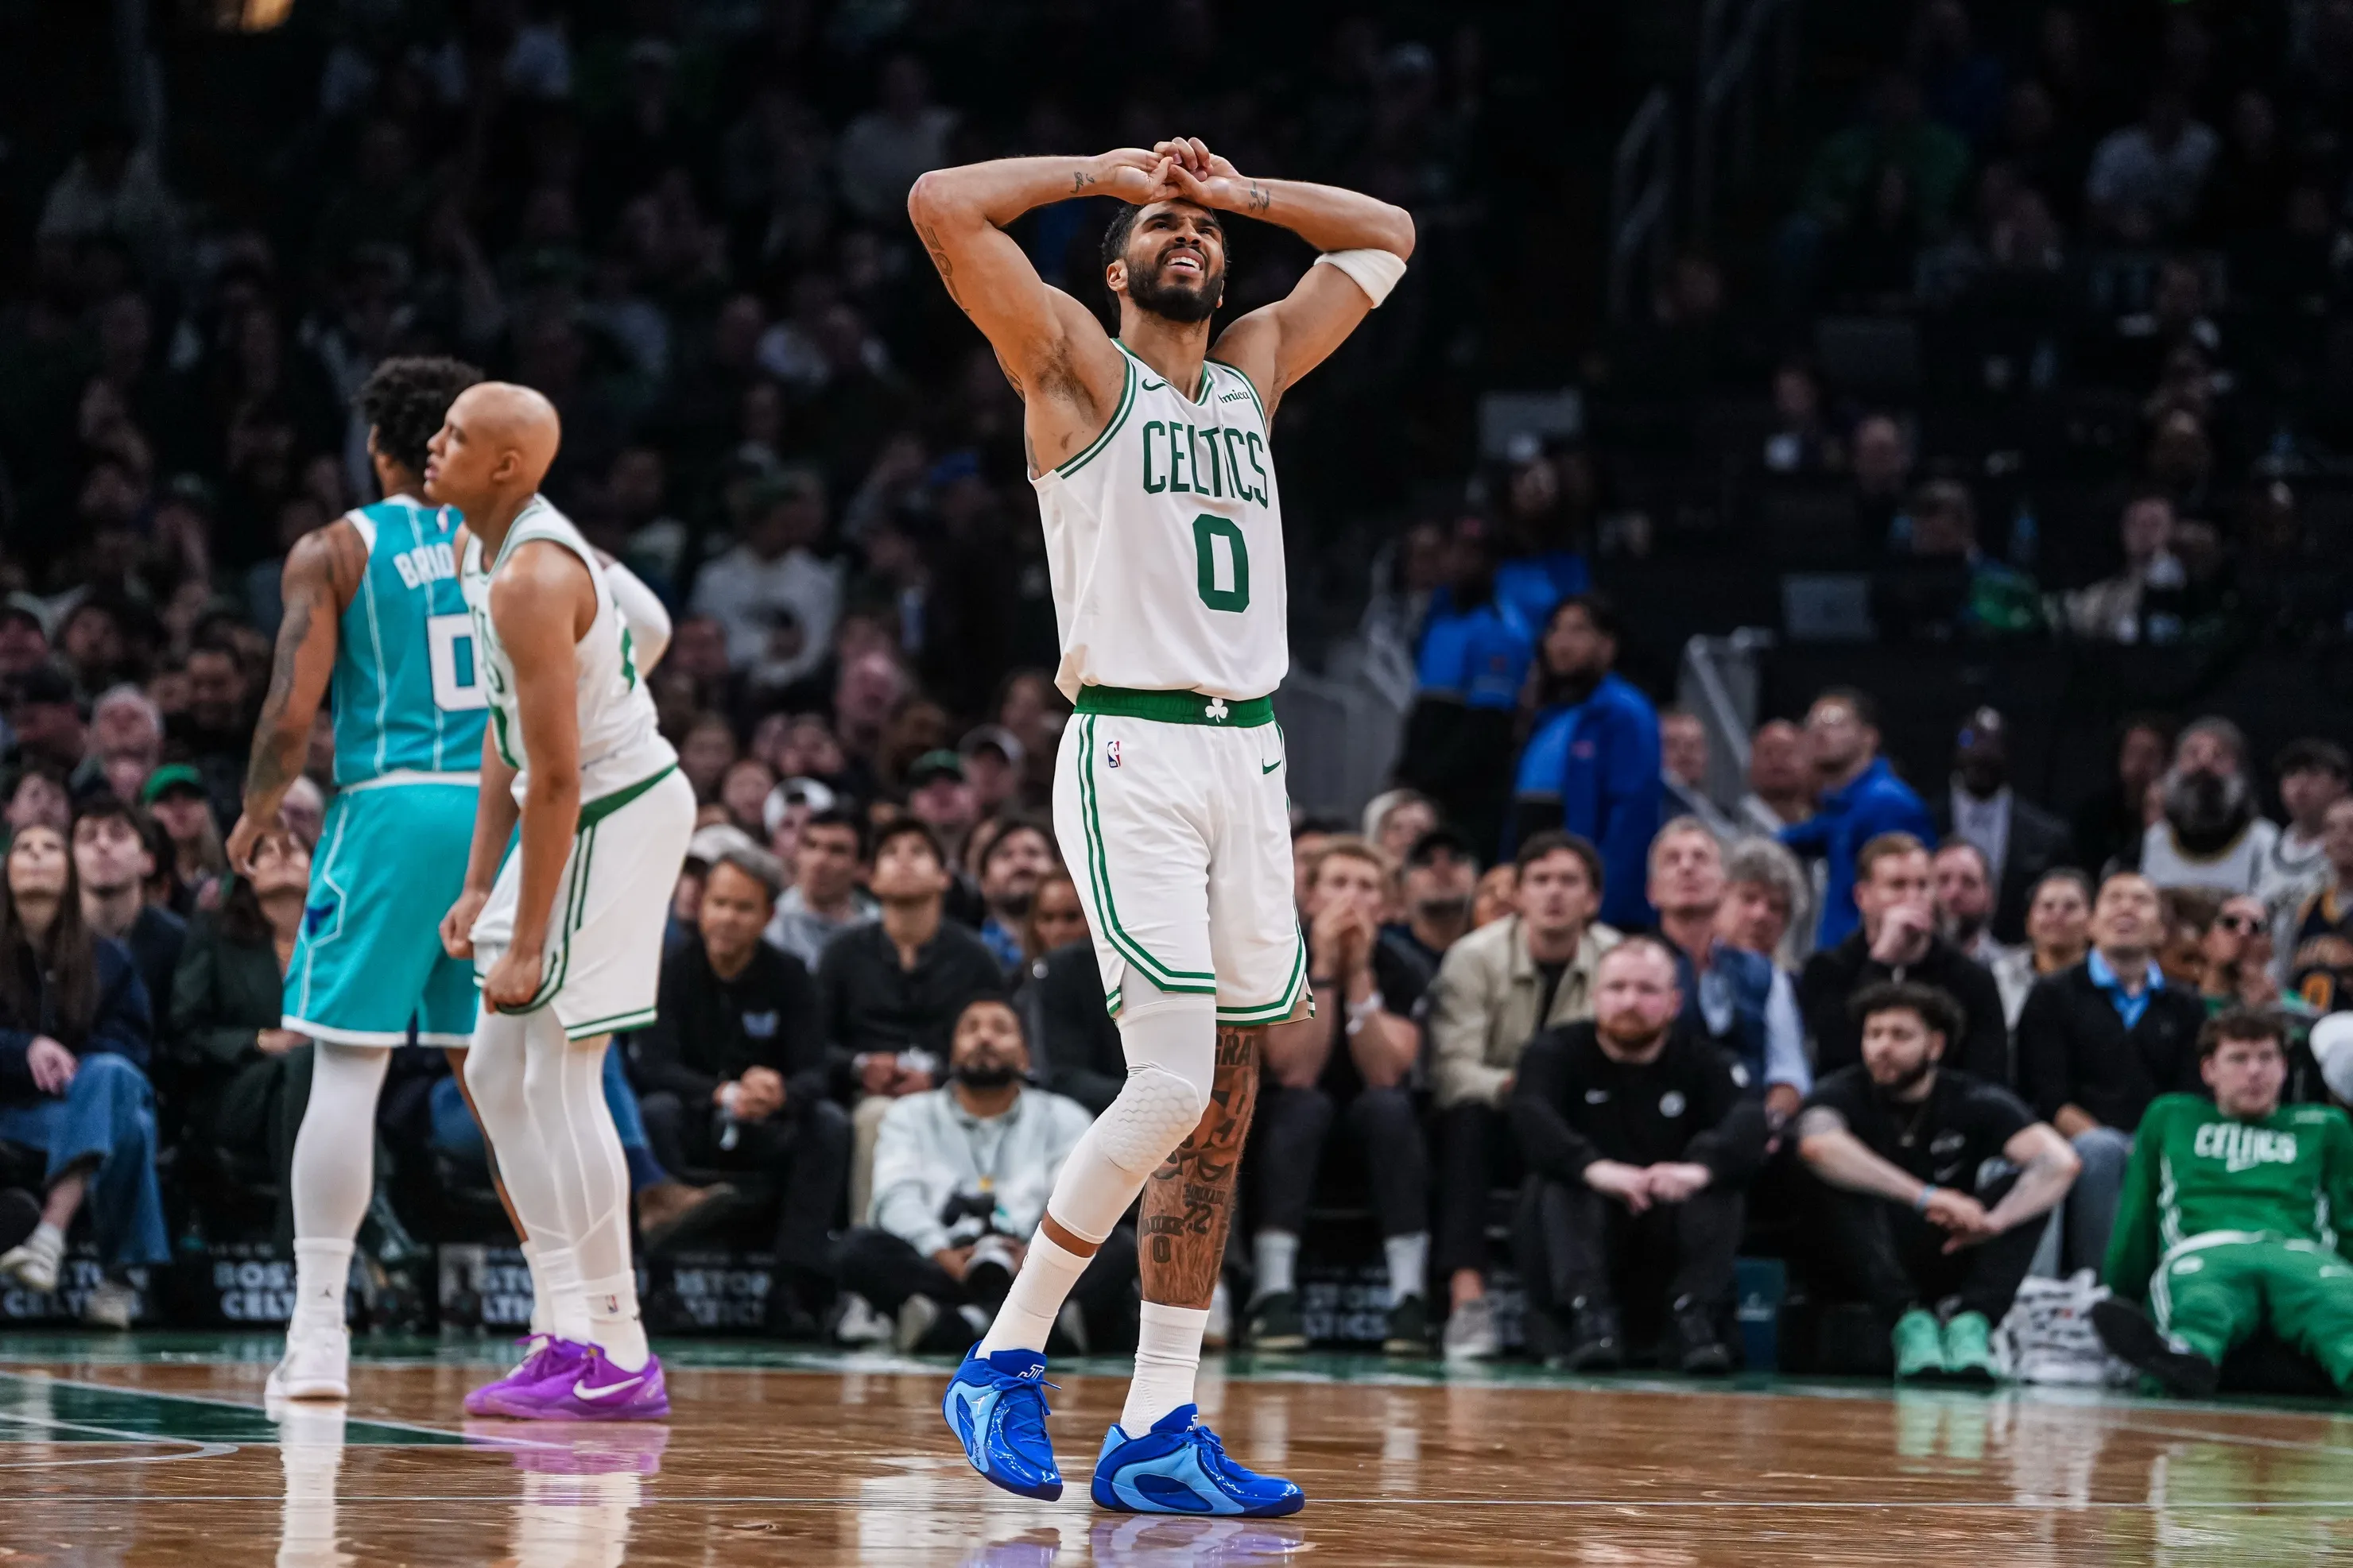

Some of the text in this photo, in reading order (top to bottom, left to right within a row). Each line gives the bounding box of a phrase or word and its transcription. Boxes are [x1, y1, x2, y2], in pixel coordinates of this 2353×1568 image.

[1142, 420, 1269, 510] CELTICS
[1192, 513, 1250, 614] 0
[427, 613, 490, 712] 0
